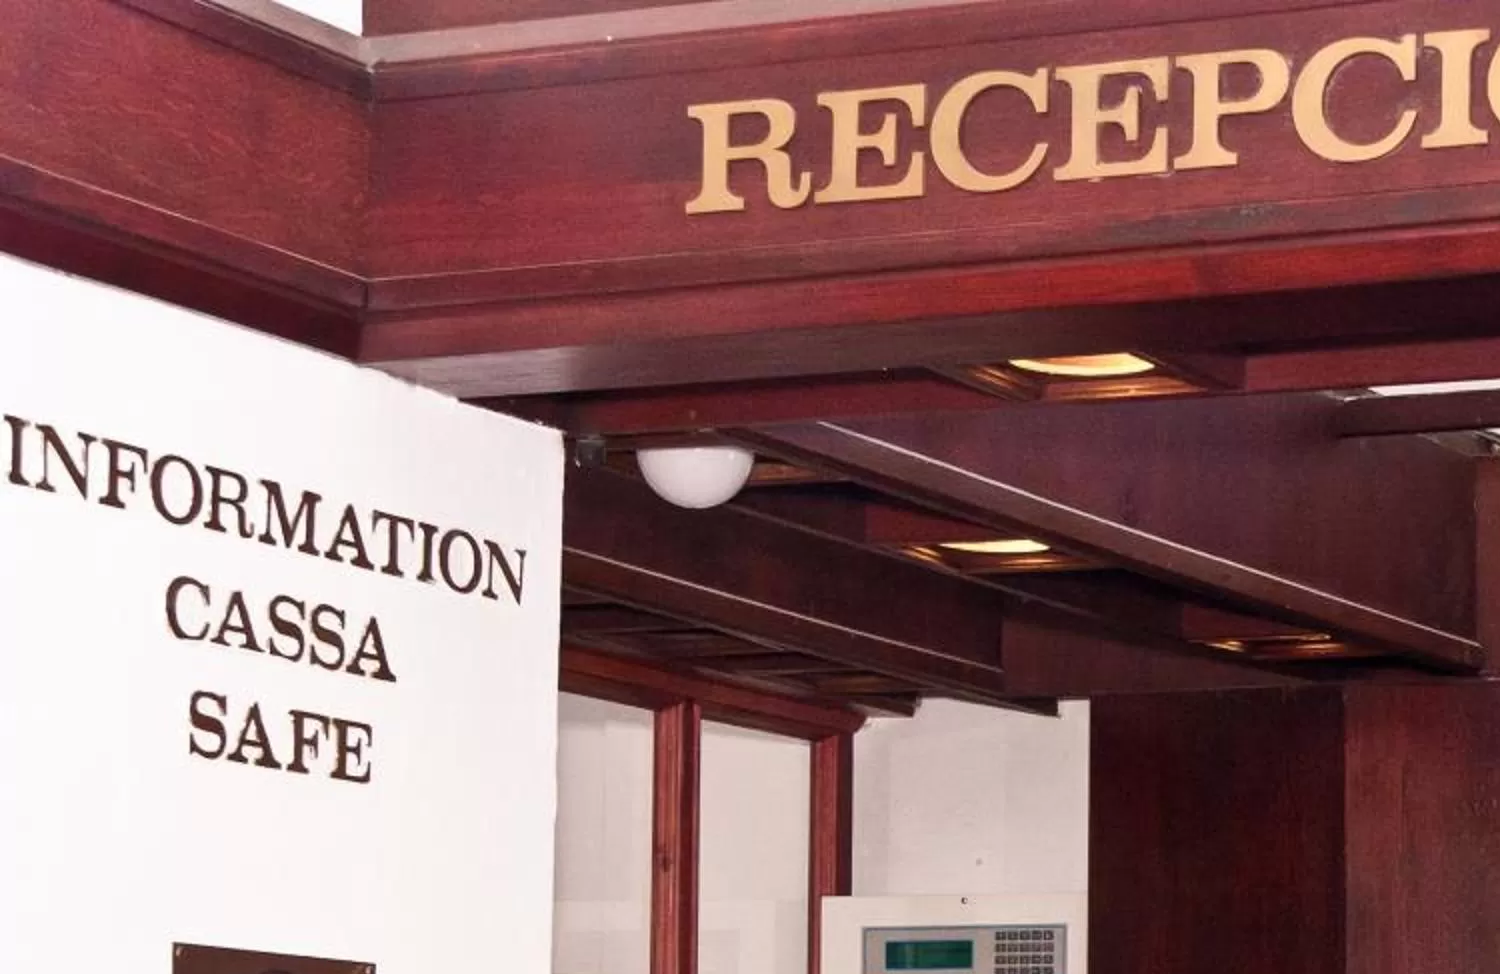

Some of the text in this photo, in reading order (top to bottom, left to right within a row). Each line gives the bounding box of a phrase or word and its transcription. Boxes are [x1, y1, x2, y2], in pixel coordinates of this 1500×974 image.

[4, 414, 527, 606] INFORMATION
[166, 575, 398, 683] CASSA
[189, 689, 373, 784] SAFE
